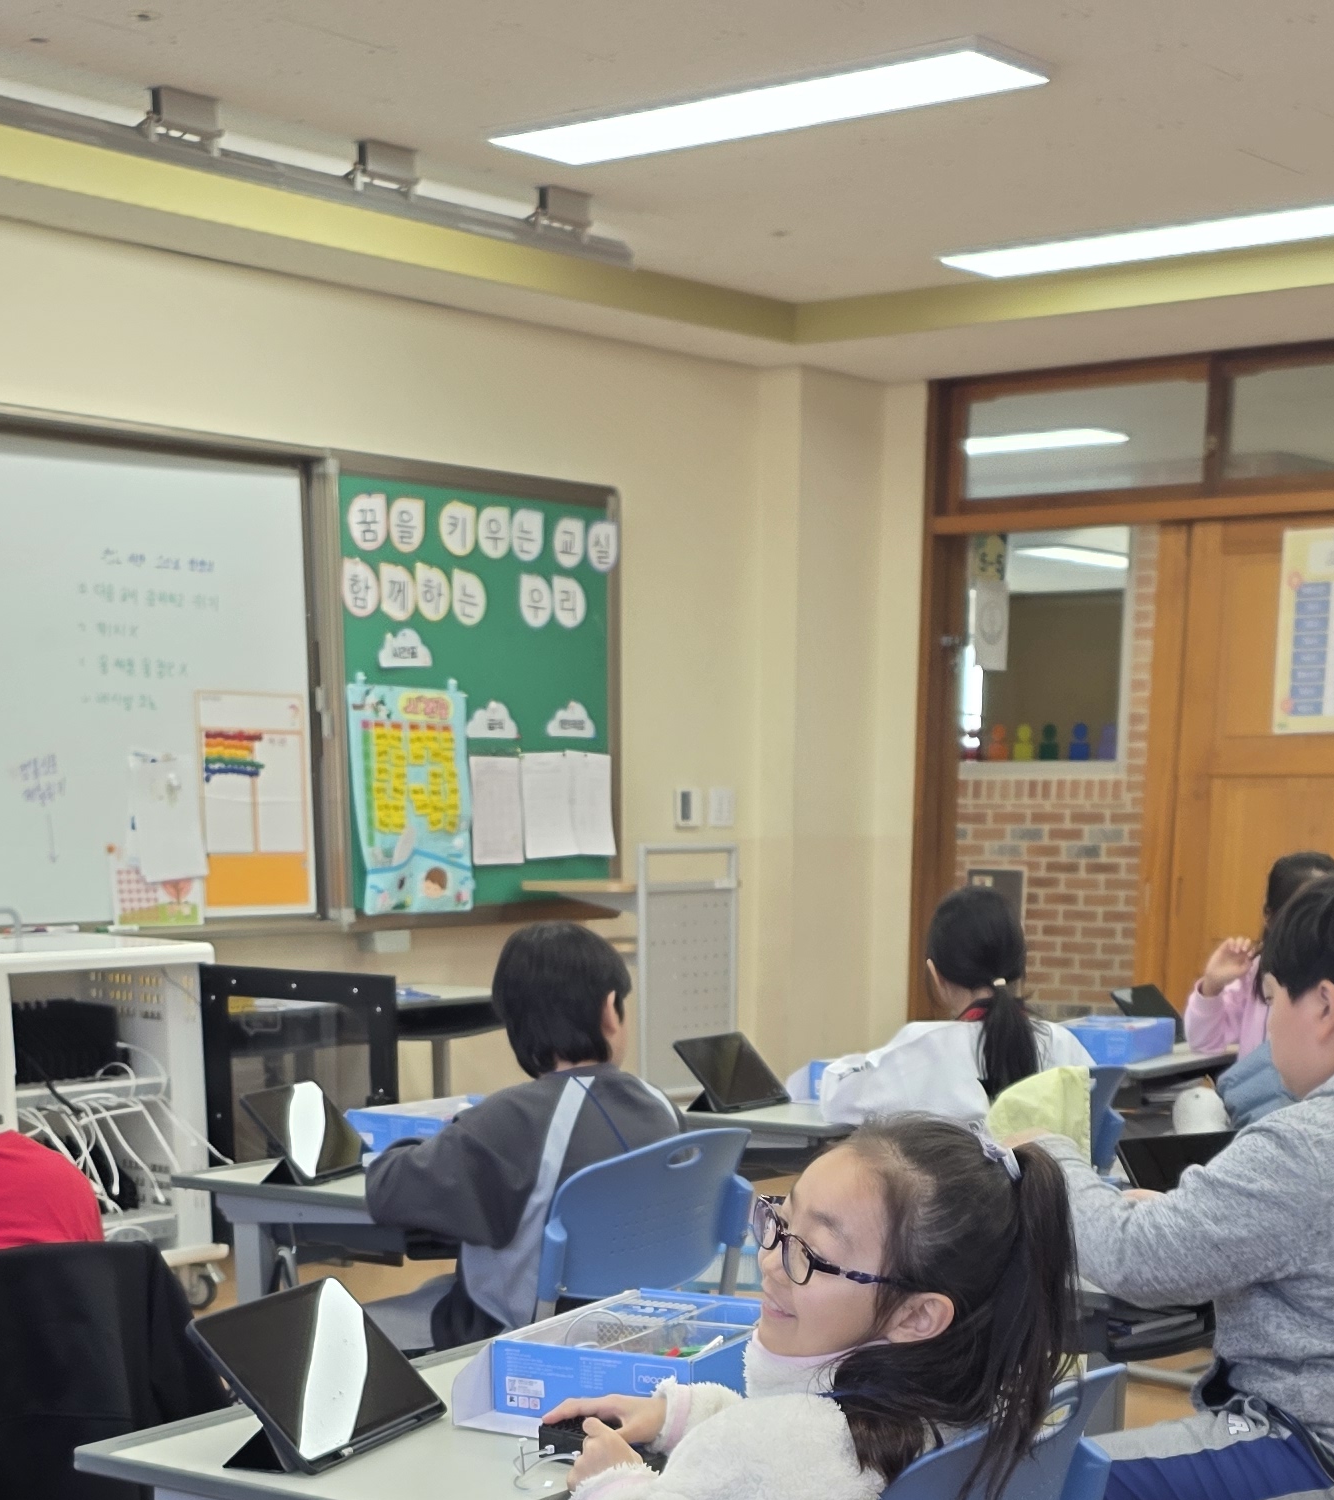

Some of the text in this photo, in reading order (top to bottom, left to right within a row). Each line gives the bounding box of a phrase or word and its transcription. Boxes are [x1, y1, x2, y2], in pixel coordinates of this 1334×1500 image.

[356, 507, 612, 566] 꿈을 키우는 교실
[348, 574, 578, 622] 함께하는 우리
